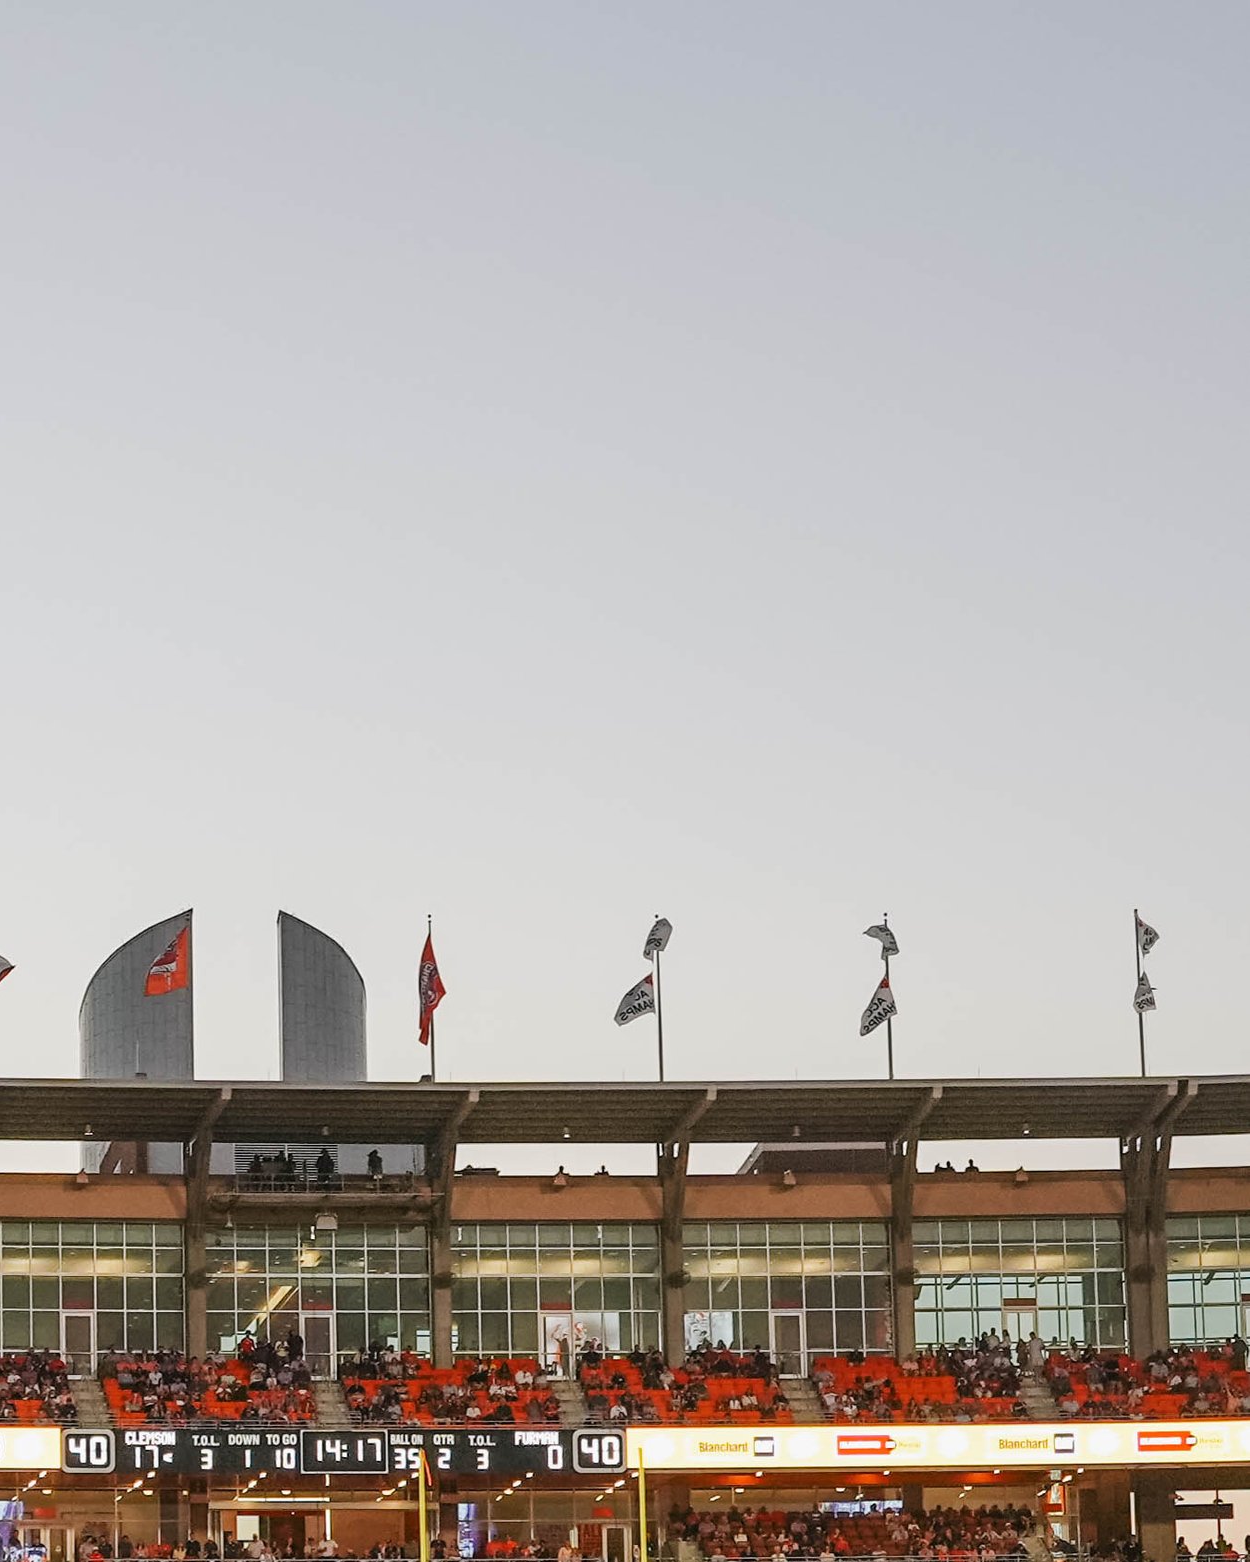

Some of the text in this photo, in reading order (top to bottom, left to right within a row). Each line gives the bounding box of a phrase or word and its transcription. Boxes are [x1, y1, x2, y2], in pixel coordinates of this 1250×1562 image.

[125, 1431, 176, 1446] CLEMSON
[192, 1434, 220, 1446] T.O.L.
[228, 1434, 260, 1446] DOWN
[266, 1434, 297, 1446] TO GO
[390, 1434, 424, 1446] BALL ON
[433, 1434, 455, 1446] QTR
[468, 1435, 496, 1447] T.O.L.
[514, 1431, 559, 1446] FURMAN
[698, 1441, 749, 1453] Blanchard
[998, 1438, 1049, 1450] Blanchard
[68, 1436, 108, 1466] 40
[134, 1446, 160, 1468] 17
[200, 1449, 214, 1470] 3
[244, 1449, 252, 1468] 1
[275, 1448, 296, 1469] 10
[316, 1438, 382, 1462] 14:17
[393, 1448, 421, 1470] 35
[437, 1448, 451, 1470] 2
[547, 1446, 563, 1470] 0
[580, 1436, 620, 1466] 40
[476, 1449, 490, 1471] 3
